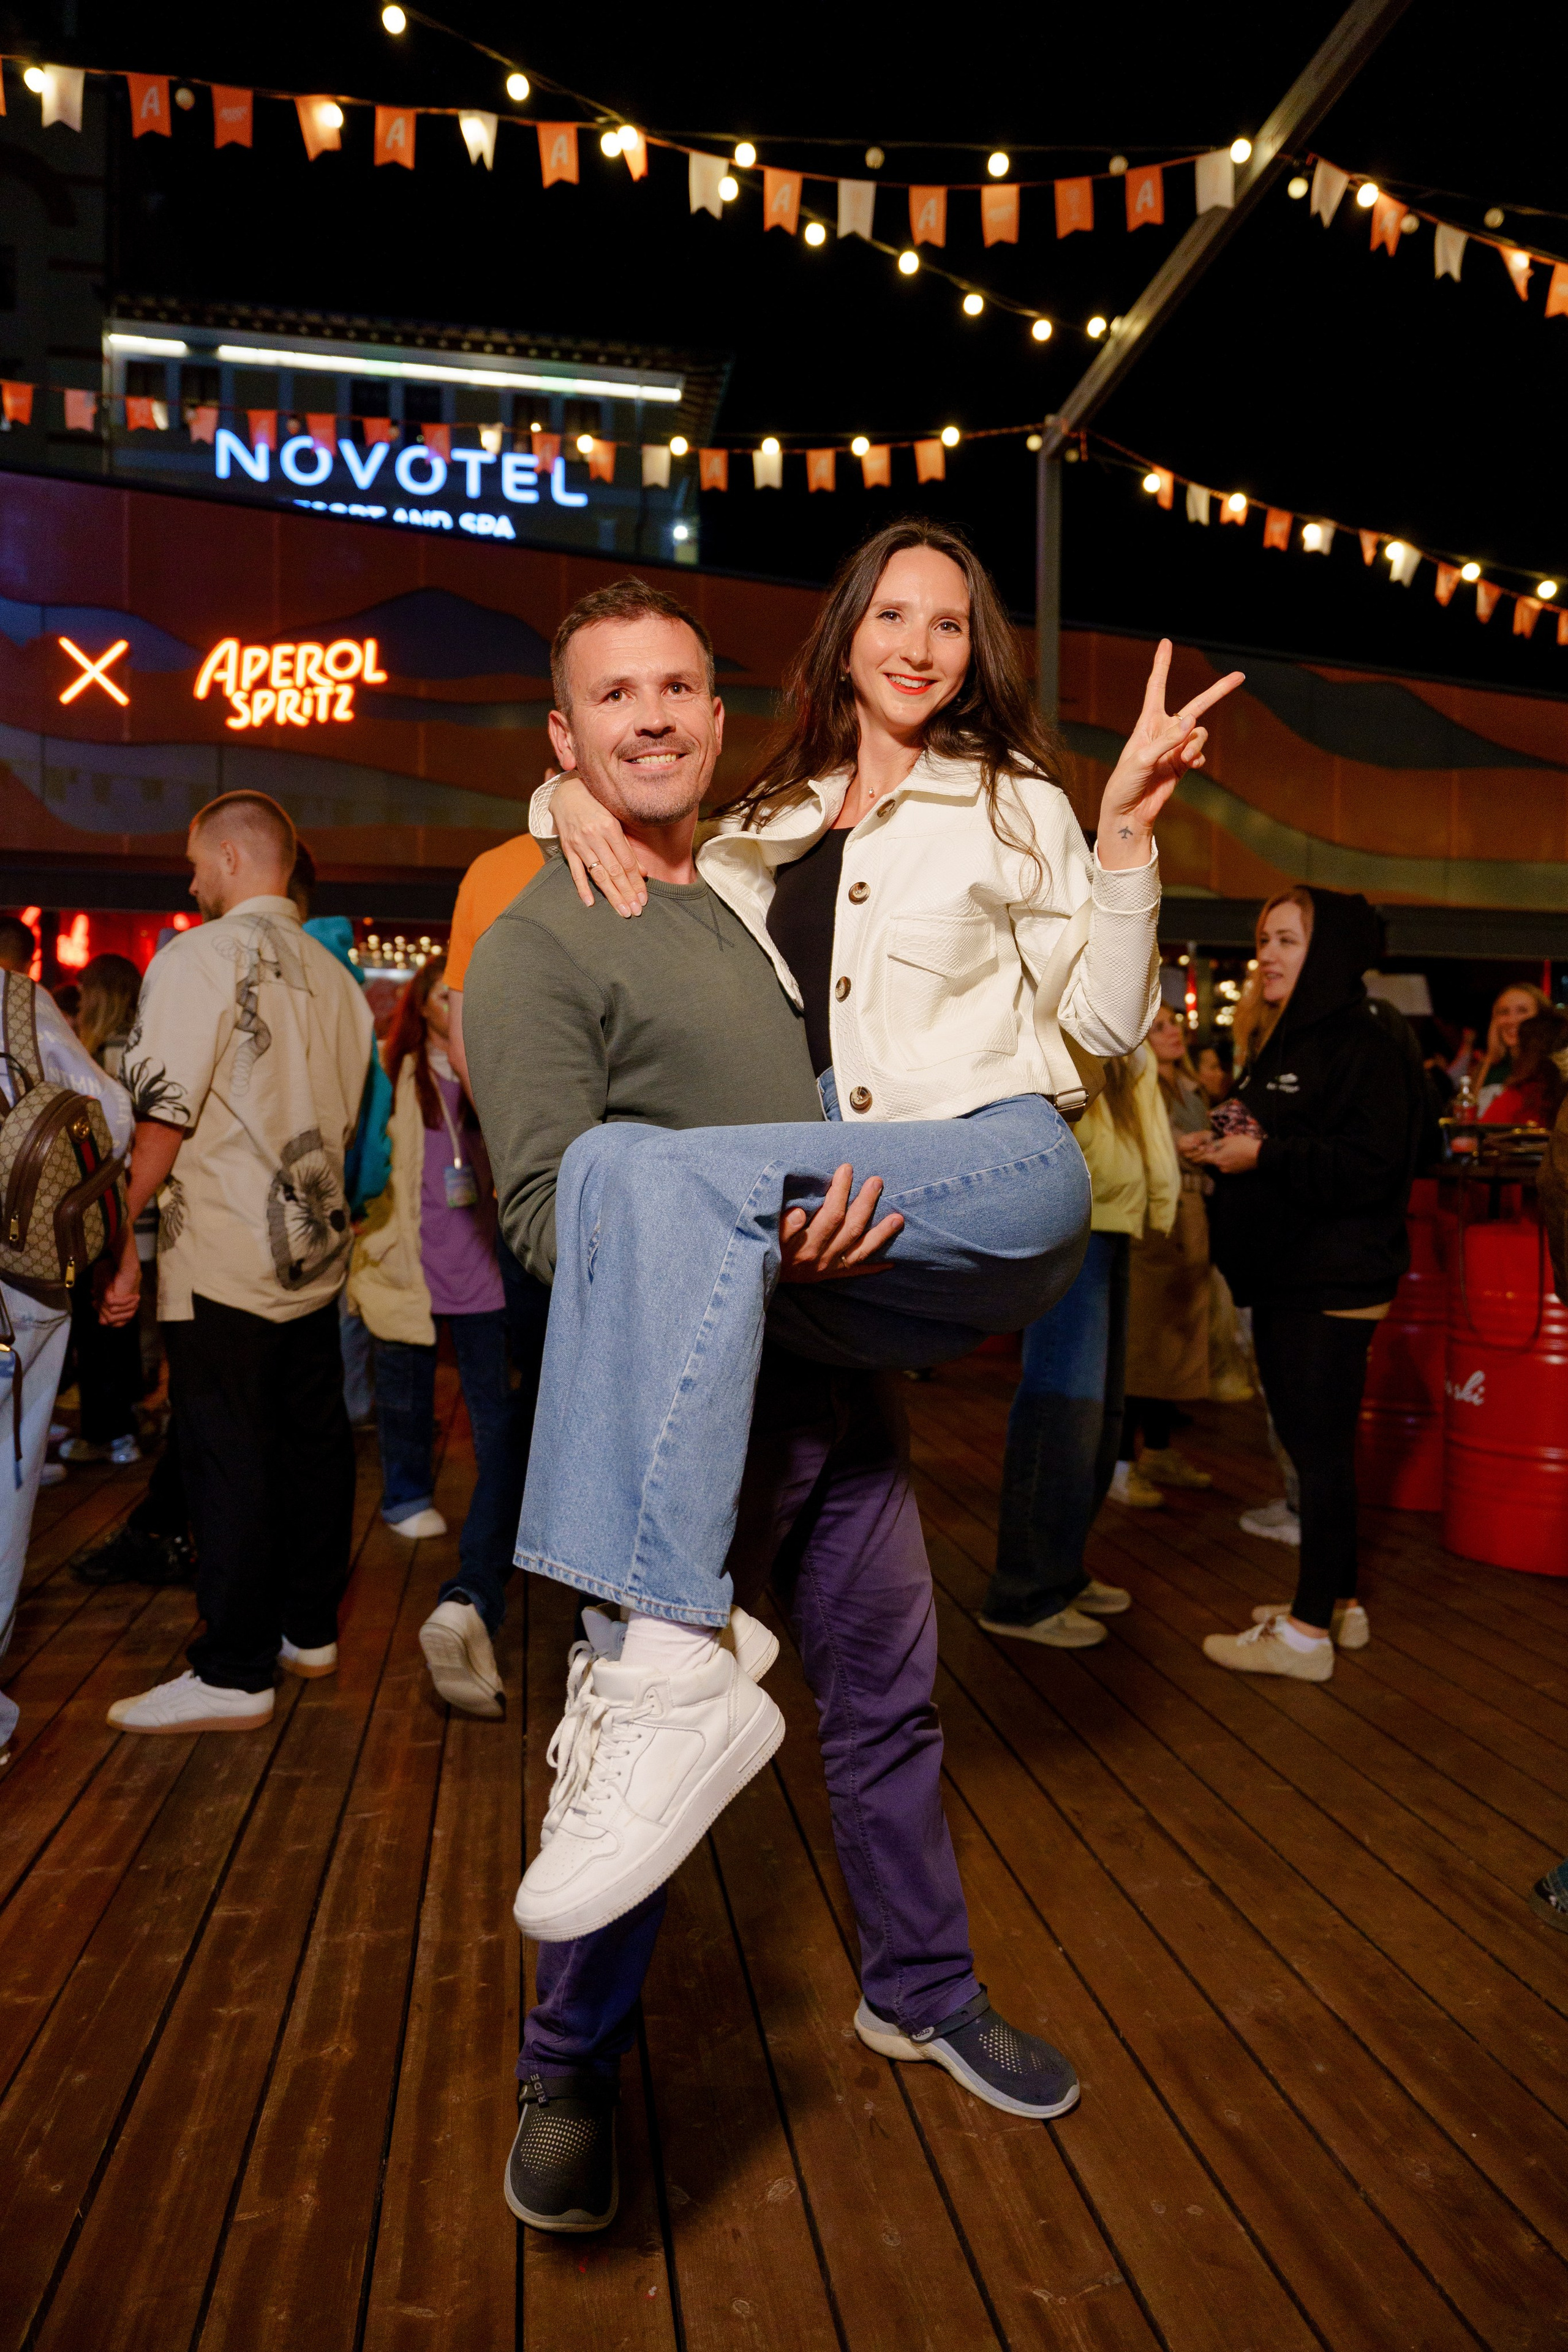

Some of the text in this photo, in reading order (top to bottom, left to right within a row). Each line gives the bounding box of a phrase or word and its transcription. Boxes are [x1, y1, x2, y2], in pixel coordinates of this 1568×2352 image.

[140, 85, 160, 119] A
[385, 116, 405, 149] A
[550, 134, 569, 170] A
[771, 184, 791, 213] A
[1135, 179, 1155, 214] A
[919, 198, 937, 230] A
[216, 428, 589, 507] NOVOTEL
[193, 637, 388, 700] APEROL
[530, 2073, 546, 2103] RIDE
